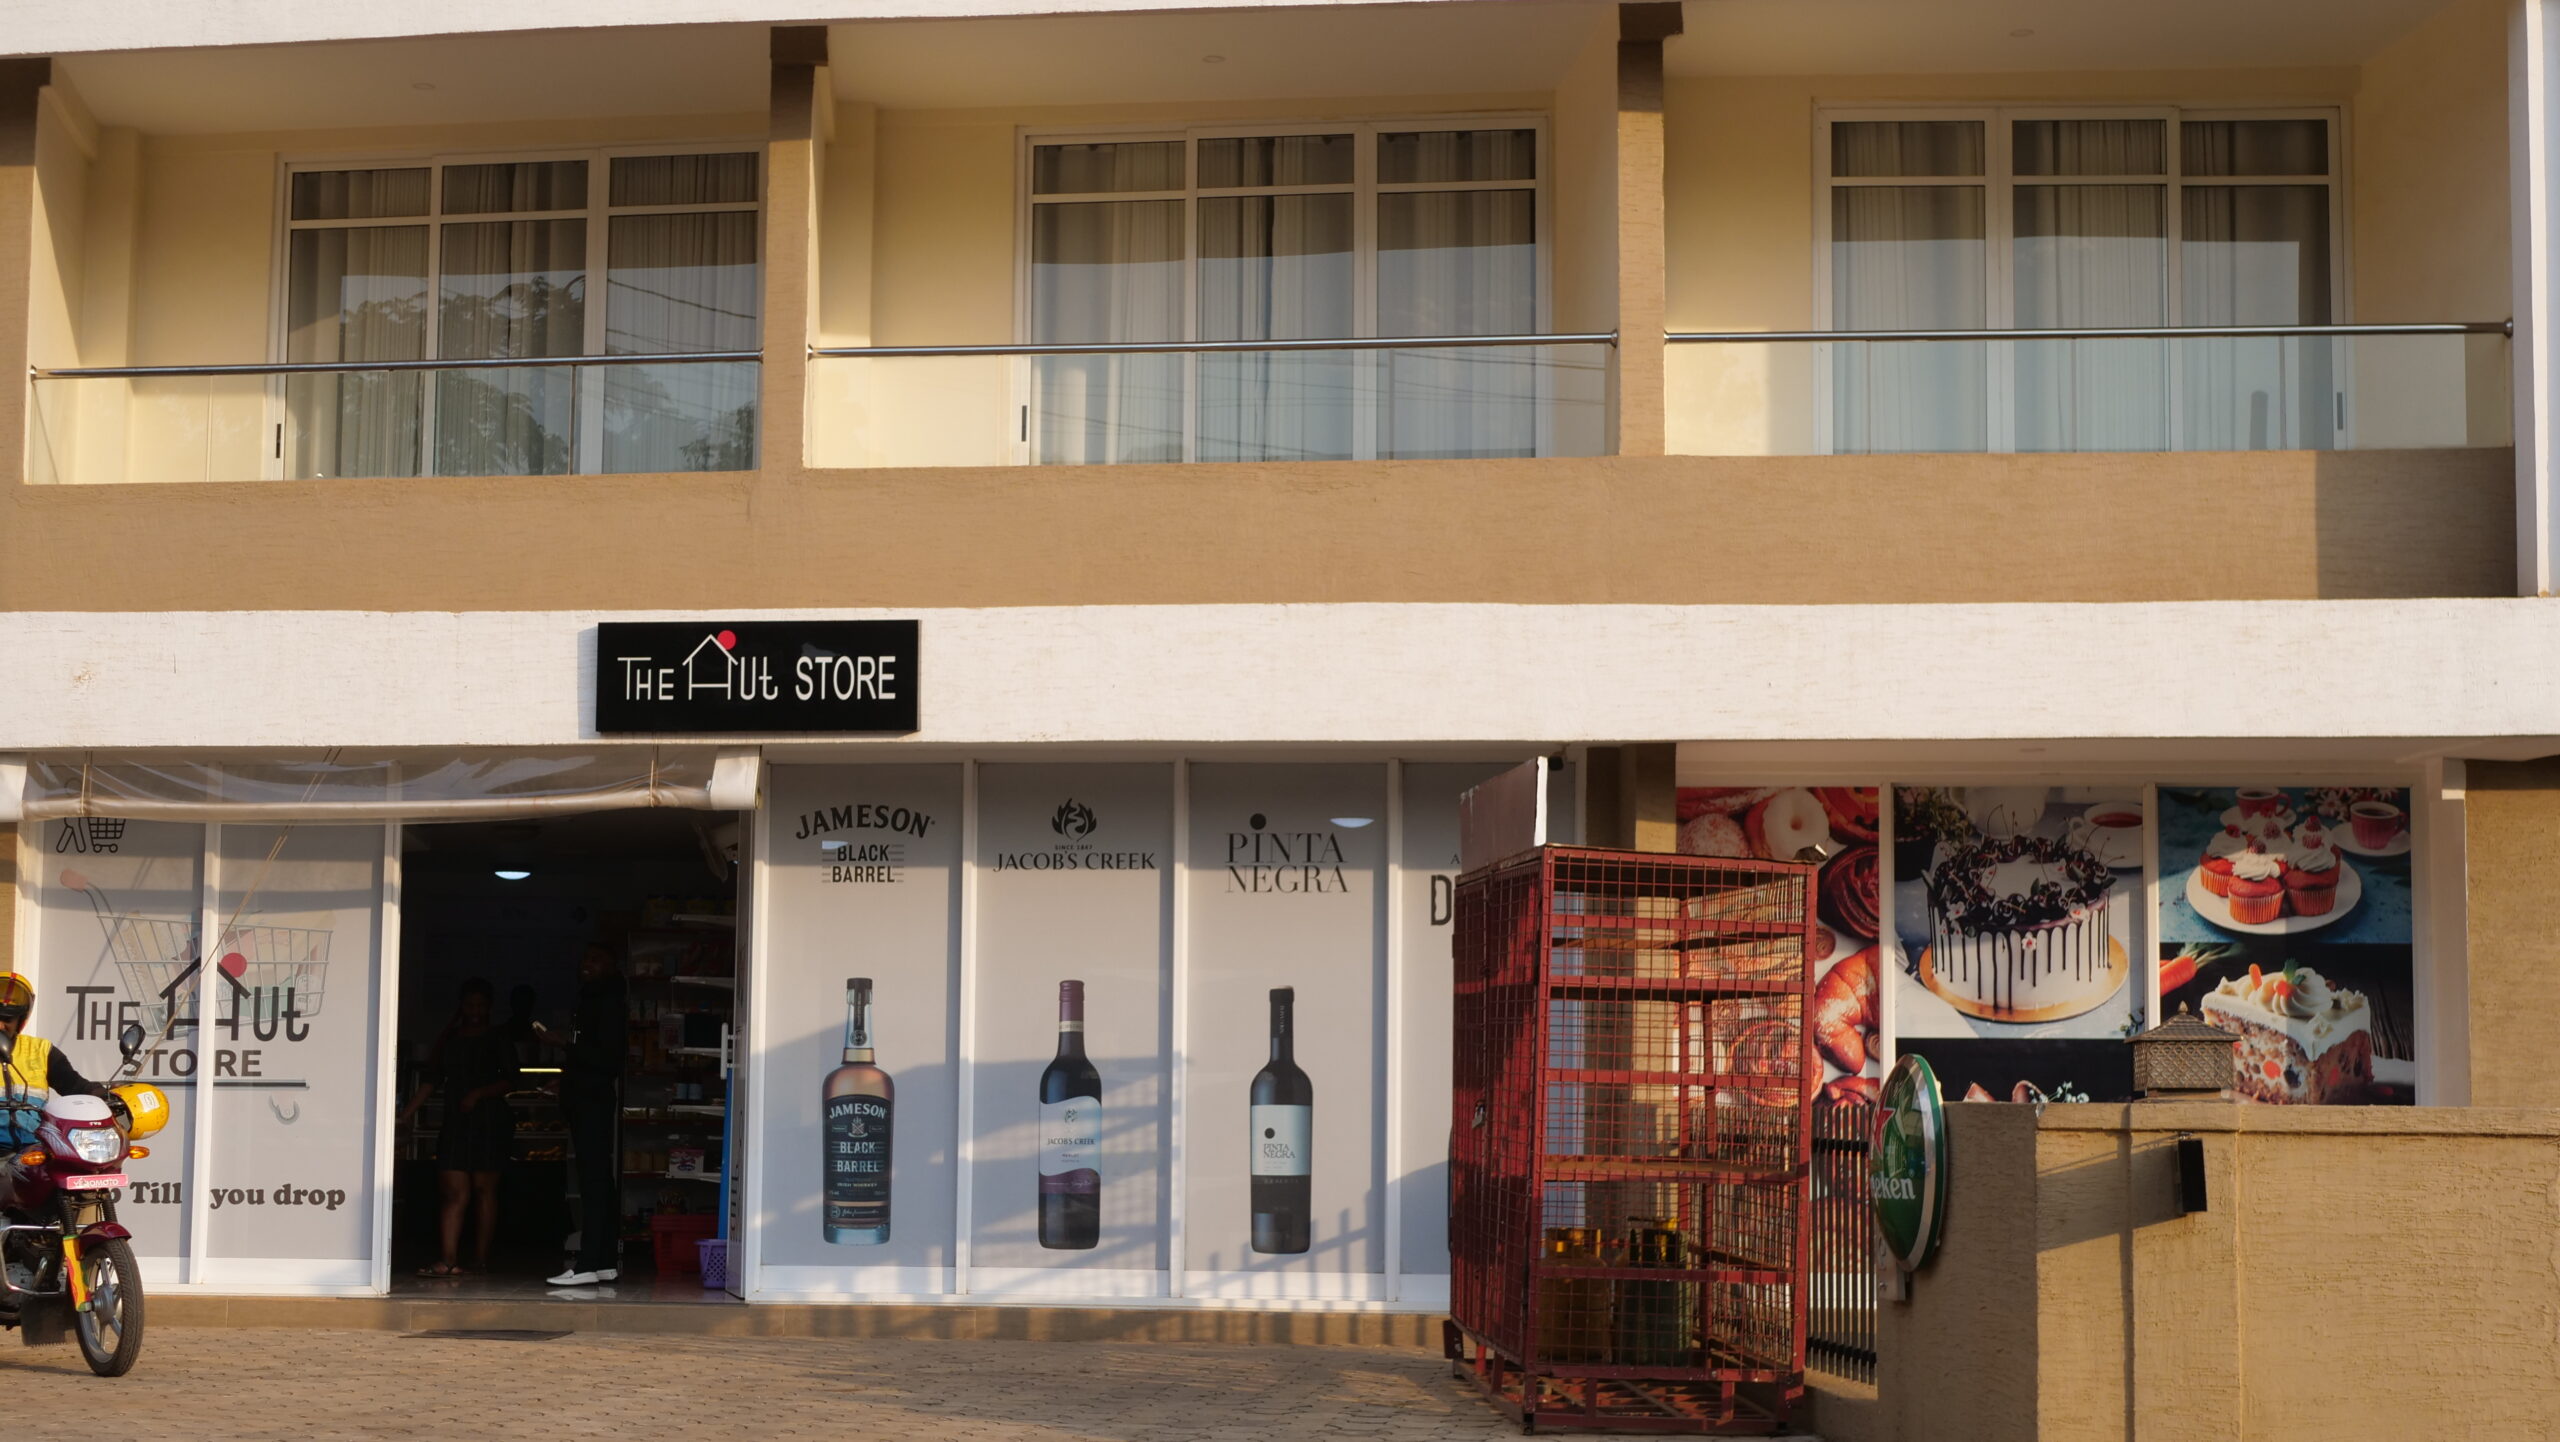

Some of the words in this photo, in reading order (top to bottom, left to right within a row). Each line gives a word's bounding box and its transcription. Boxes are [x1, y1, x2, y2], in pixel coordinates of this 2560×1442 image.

[617, 656, 674, 700] THE
[795, 656, 896, 700] STORE
[796, 804, 931, 840] JAMESON
[837, 844, 890, 862] BLACK
[1225, 832, 1348, 863] PINTA
[993, 851, 1078, 872] JACOB'S
[1085, 852, 1156, 871] CREEK
[832, 866, 895, 883] BARREL
[1225, 865, 1351, 893] NEGRA
[66, 986, 140, 1041] THE
[122, 1049, 262, 1077] STORE
[829, 1103, 886, 1119] JAMESON
[840, 1141, 876, 1154] BLACK
[1263, 1143, 1290, 1152] PINTA
[1263, 1151, 1296, 1159] NEGRA
[837, 1160, 879, 1173] BARREL
[130, 1181, 182, 1204] Till
[210, 1188, 265, 1210] you
[273, 1183, 346, 1210] drop
